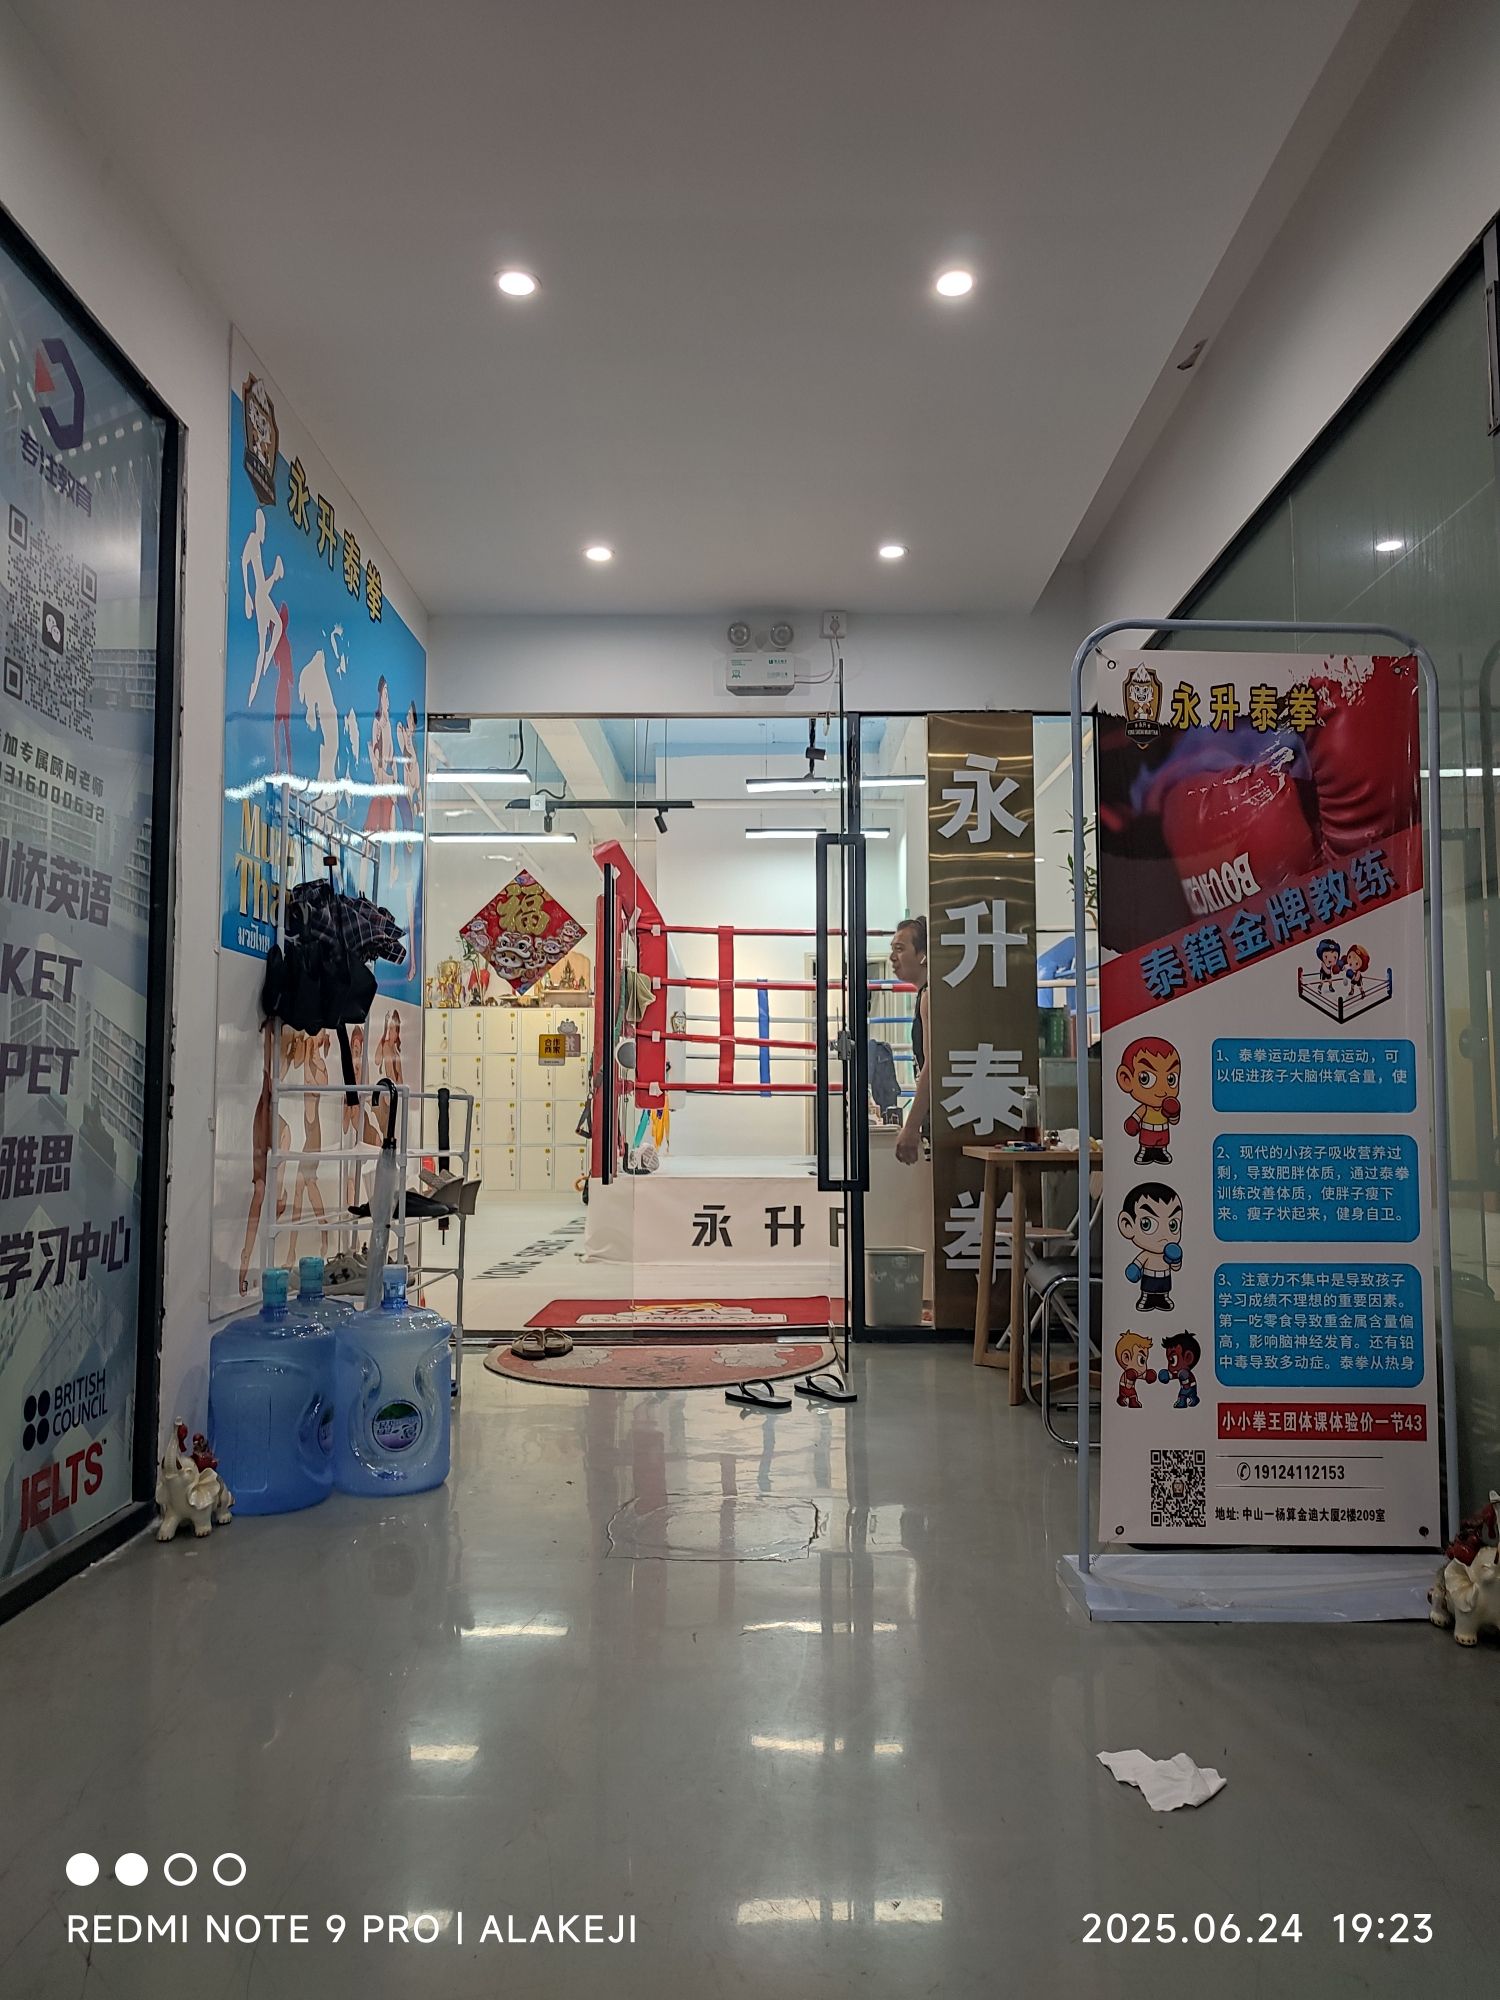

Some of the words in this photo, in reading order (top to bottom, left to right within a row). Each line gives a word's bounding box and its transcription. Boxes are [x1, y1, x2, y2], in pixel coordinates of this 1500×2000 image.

[21, 428, 93, 518] 专注教育
[288, 456, 382, 623] 永升泰拳
[1171, 681, 1319, 734] 永升泰拳
[0, 732, 104, 798] 加专属顾问老师
[0, 763, 105, 823] 316000632
[497, 883, 550, 935] 福
[1139, 849, 1396, 998] 泰籍金牌教练
[0, 943, 83, 1004] KET
[0, 1043, 80, 1096] PET
[1216, 1069, 1408, 1084] 以促进孩子大脑供氧含量，使
[0, 1216, 131, 1301] 学习中心
[52, 1393, 108, 1436] COUNCIL
[54, 1369, 106, 1410] BRITISH
[1222, 1410, 1423, 1433] 小小拳王团体课体验价一节43
[20, 1441, 103, 1533] IELTS
[1254, 1464, 1345, 1480] 19124112153
